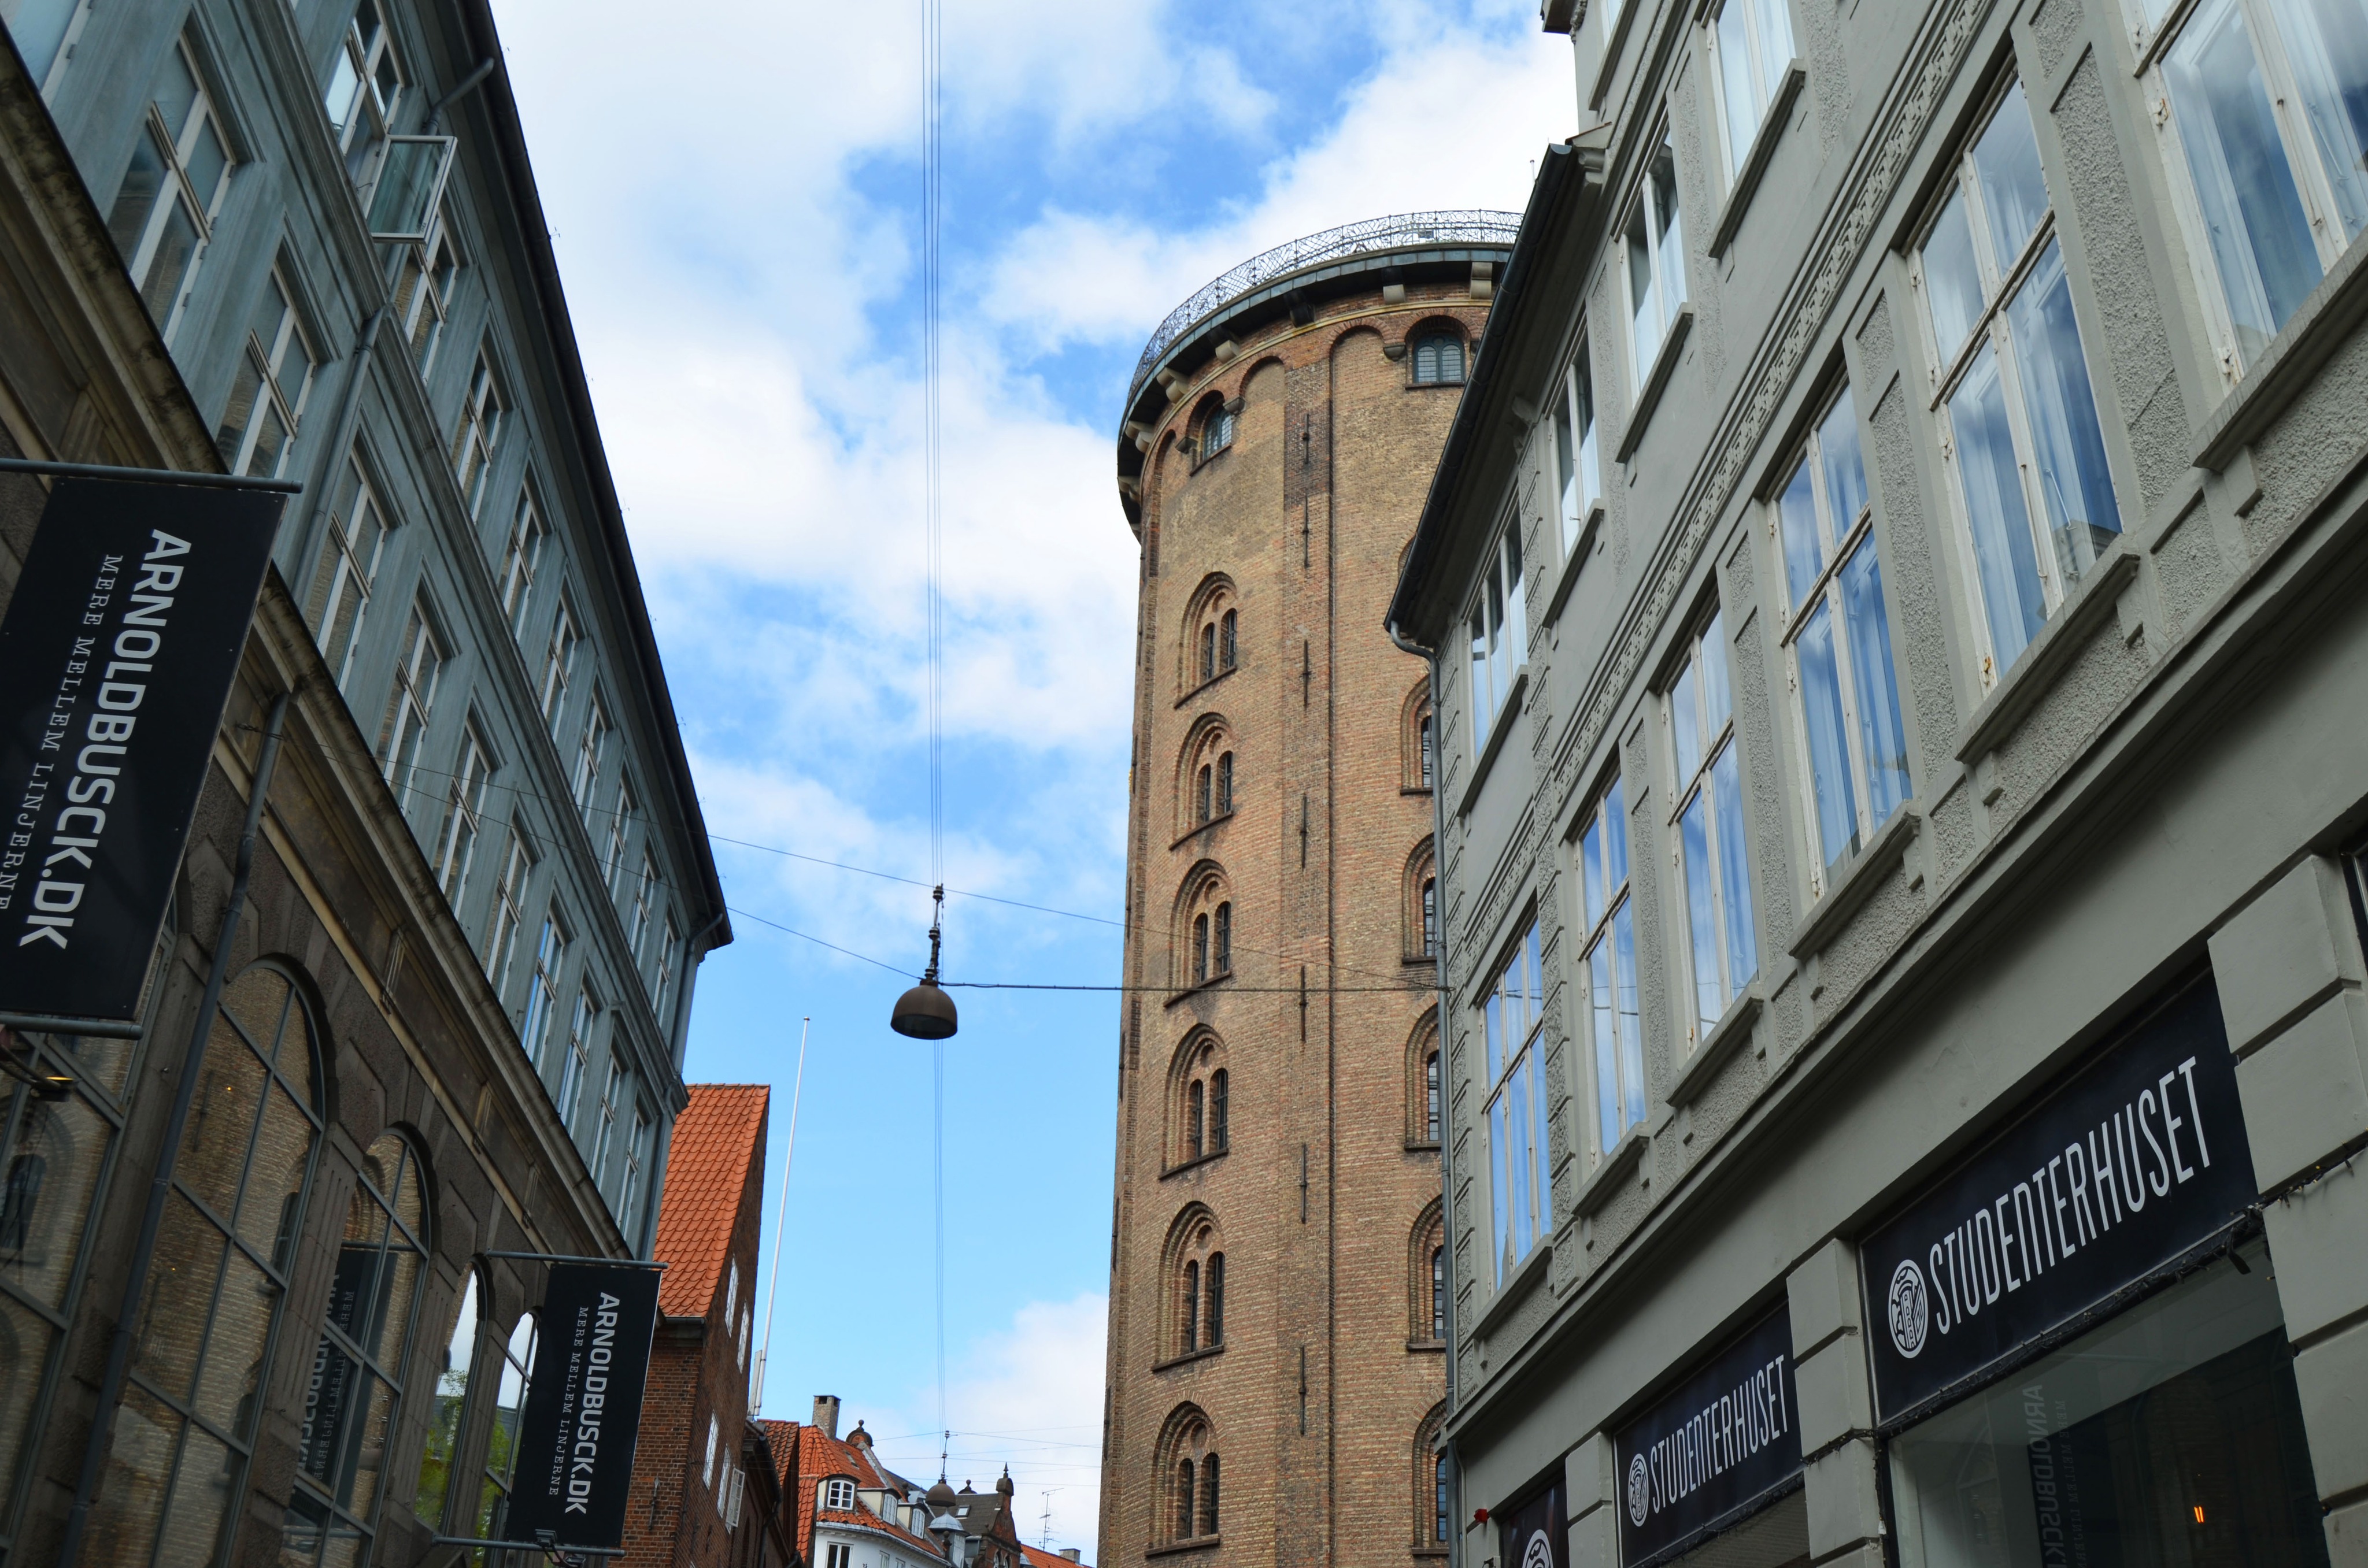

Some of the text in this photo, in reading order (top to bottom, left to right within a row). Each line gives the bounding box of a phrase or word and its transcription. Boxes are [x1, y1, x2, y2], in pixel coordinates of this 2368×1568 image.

[83, 554, 123, 625] MERE
[20, 529, 191, 949] ARNOLDBUSCK.DK
[41, 636, 95, 751] MELLEM
[1929, 1056, 2211, 1335] STUDENTERHUSET
[549, 1307, 589, 1496] MERE MELLEM LINJERNE
[565, 1292, 620, 1514] ARNOLDBUSCK.DK
[1651, 1354, 1788, 1514] STUDENTERHUSET
